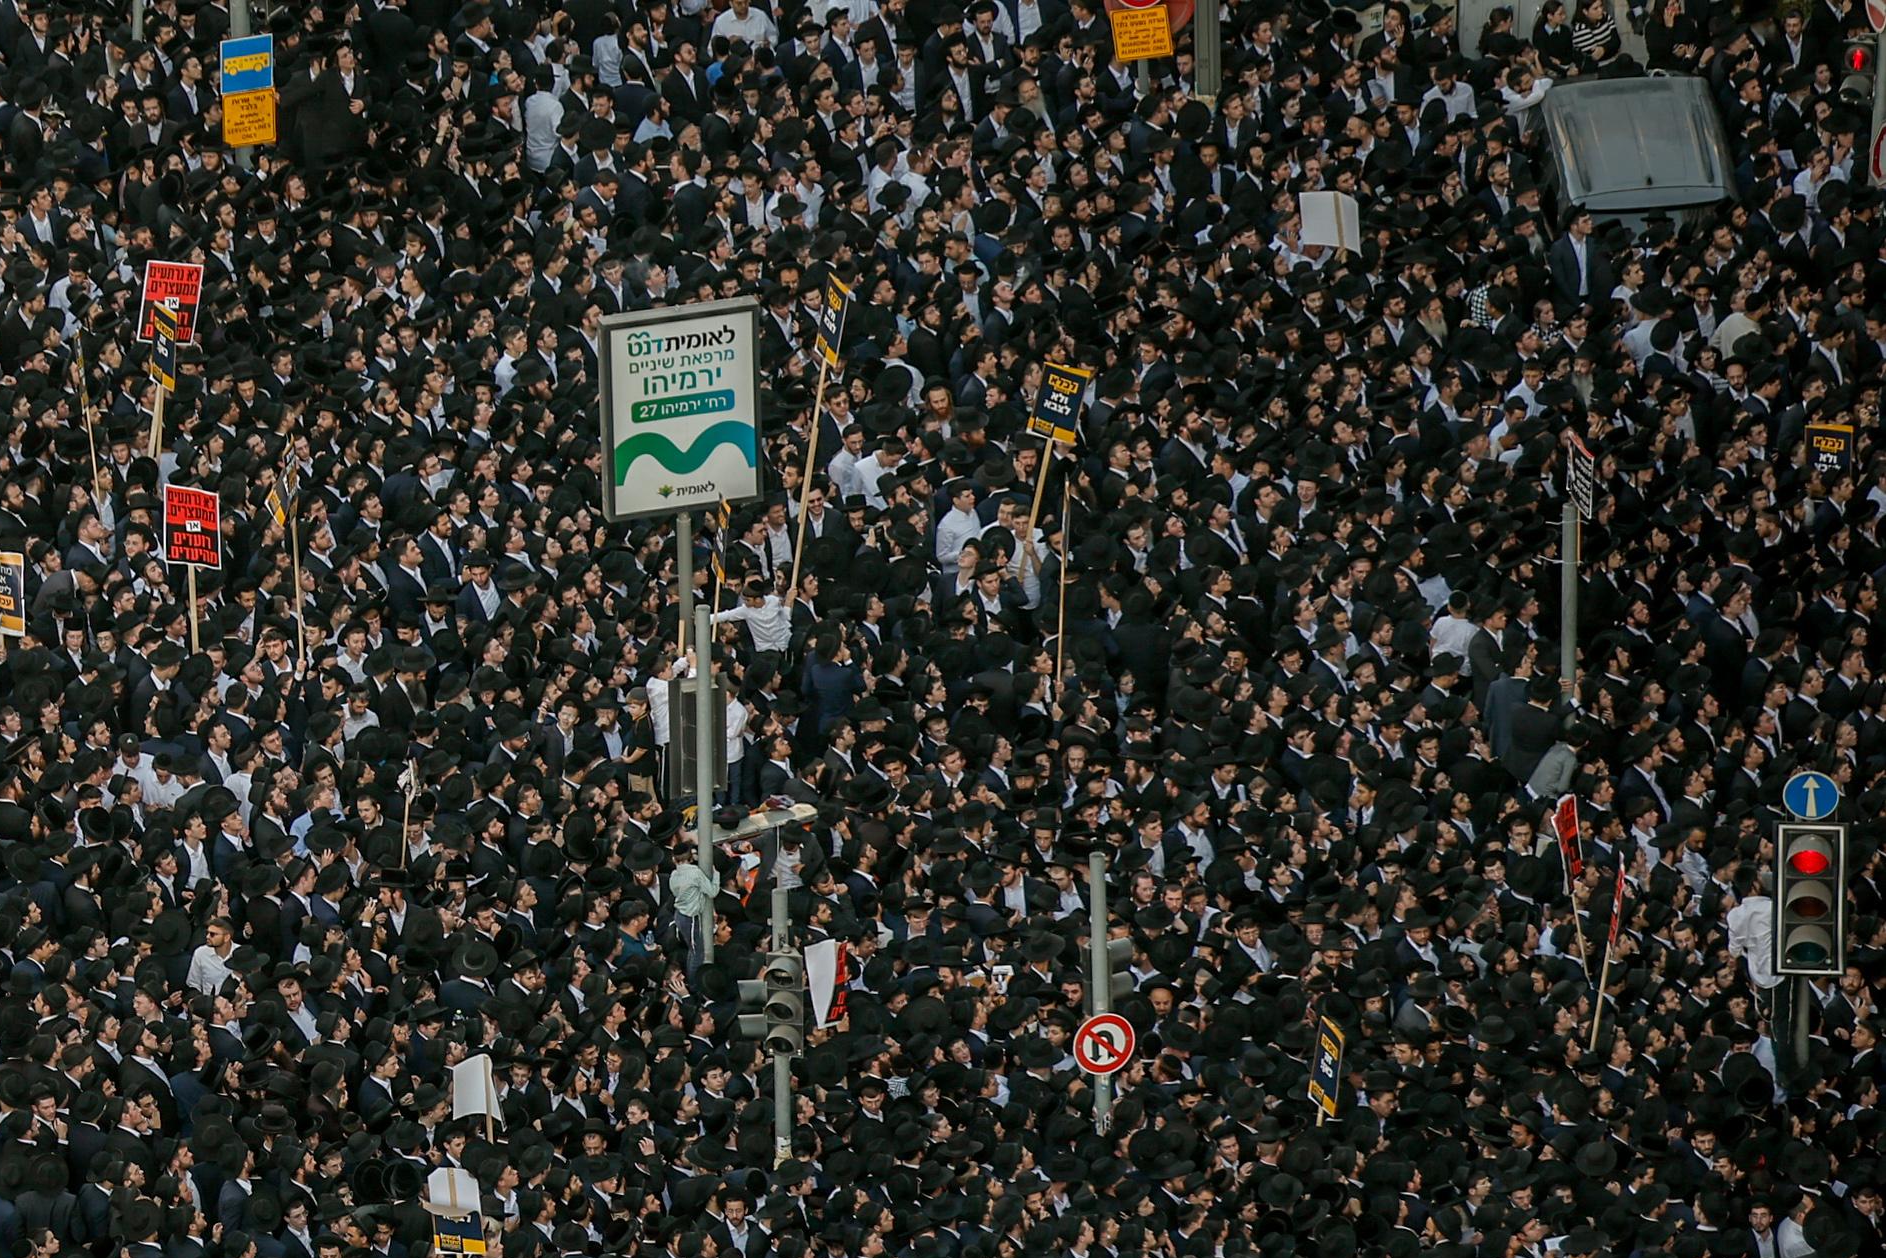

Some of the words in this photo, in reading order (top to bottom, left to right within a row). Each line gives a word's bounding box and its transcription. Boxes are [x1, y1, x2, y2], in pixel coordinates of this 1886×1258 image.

[150, 266, 184, 280] נרתעים
[187, 267, 200, 282] לא
[146, 279, 197, 297] ממעצרים.
[168, 299, 178, 308] אך
[629, 357, 674, 374] שיניים
[680, 348, 735, 368] מרפאת
[643, 367, 722, 396] ירמיהו
[1051, 376, 1078, 392] לכלא
[1050, 391, 1068, 404] ולא
[640, 404, 657, 418] 27
[661, 399, 701, 415] ירמיהו
[1043, 399, 1072, 416] לצבא
[1815, 438, 1842, 450] לכלא
[1819, 453, 1837, 464] ולא
[675, 480, 715, 497] לאומית
[168, 491, 202, 506] נרתעים
[203, 495, 214, 509] לא
[167, 503, 215, 523] ממעצרים.
[188, 522, 199, 531] אך
[174, 532, 211, 549] רועדים
[168, 546, 218, 565] מהיעדים.
